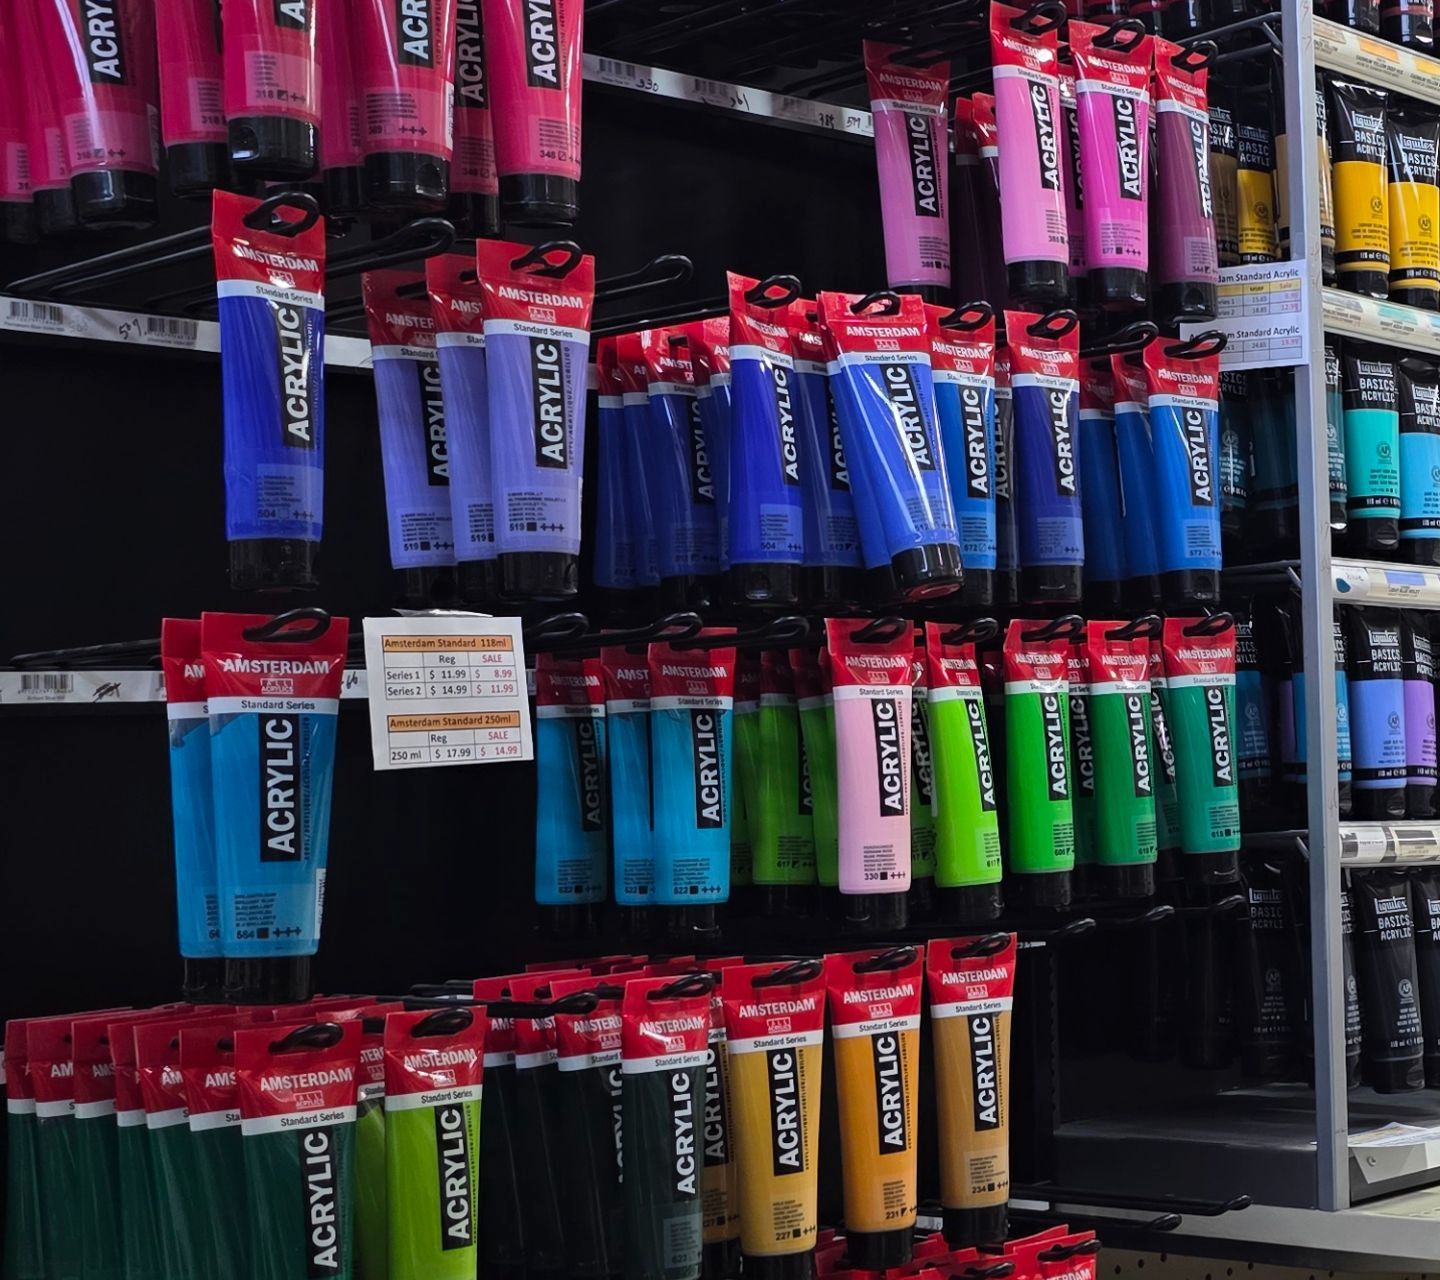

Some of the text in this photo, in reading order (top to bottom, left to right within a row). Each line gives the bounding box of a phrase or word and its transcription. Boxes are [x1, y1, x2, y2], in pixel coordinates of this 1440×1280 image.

[1235, 268, 1299, 282] Standard Acrylic
[498, 285, 583, 309] AMSTERDAM
[1236, 325, 1300, 339] Standard Acrylic
[1359, 377, 1397, 392] BASICS
[534, 343, 564, 463] ACRYLIC
[508, 522, 525, 532] 519
[385, 638, 507, 649] Amsterdam Standard 118ml
[439, 655, 456, 665] Reg
[482, 655, 503, 663] SALE
[223, 658, 330, 675] AMSTERDAM
[387, 671, 414, 680] Series
[441, 670, 467, 679] 11.99
[494, 670, 513, 679] 8.99
[387, 687, 415, 696] Series
[442, 686, 468, 695] 14.99
[491, 684, 514, 693] 11.99
[390, 714, 512, 728] Amsterdam Standard 250ml
[431, 734, 447, 744] Reg
[488, 731, 509, 740] SALE
[391, 750, 421, 761] 250 ml
[447, 748, 471, 758] 17.99
[495, 746, 518, 756] 14.99
[876, 702, 903, 812] ACRYLIC
[265, 718, 296, 854] ACRYLIC
[864, 871, 880, 881] 330
[259, 1068, 354, 1093] AMSTERDAM
[877, 1034, 904, 1149] ACRYLIC
[773, 1050, 802, 1169] ACRYLIC
[304, 1131, 340, 1269] ACRYLIC
[775, 1230, 793, 1241] 227
